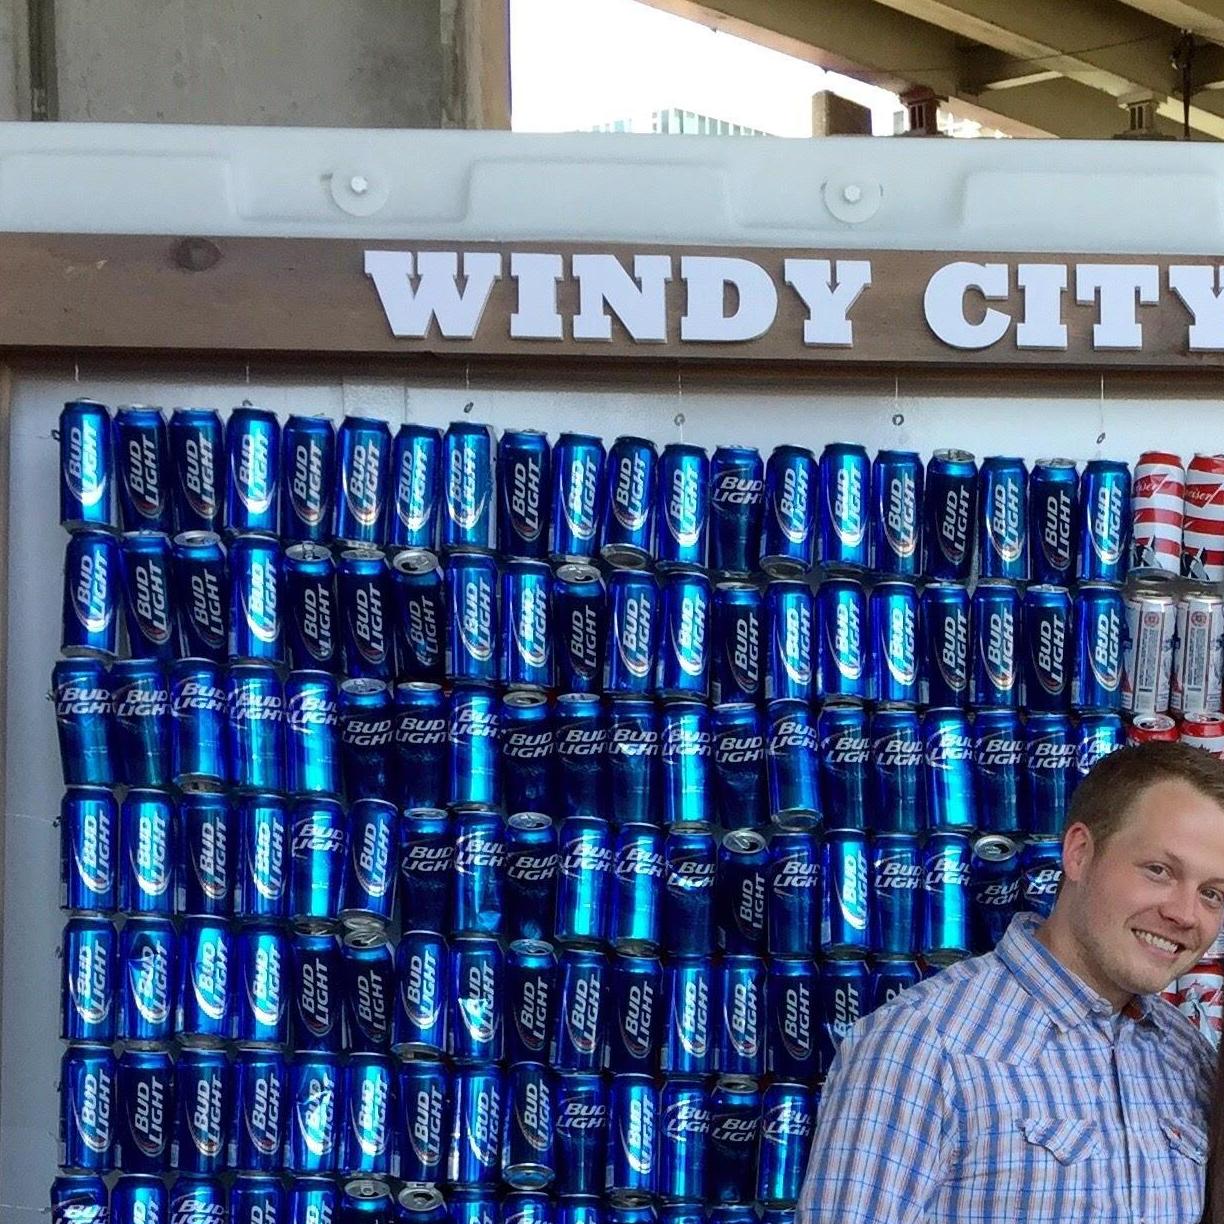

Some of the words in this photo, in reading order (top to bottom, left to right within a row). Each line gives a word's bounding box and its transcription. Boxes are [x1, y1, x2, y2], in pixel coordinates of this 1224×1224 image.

[363, 249, 872, 348] WINDY
[69, 426, 82, 478] BUD
[130, 440, 142, 495] BUD
[143, 434, 158, 508] LIGHT
[186, 440, 199, 494] BUD
[200, 436, 214, 513] LIGHT
[239, 435, 254, 481] BUD
[294, 445, 306, 498] BUD
[307, 440, 323, 513] LIGHT
[350, 445, 365, 496] BUD
[363, 439, 381, 518] LIGHT
[512, 463, 527, 516] BUD
[526, 458, 540, 532] LIGHT
[617, 458, 631, 506] BUD
[629, 452, 646, 519] LIGHT
[670, 468, 683, 519] BUD
[721, 477, 762, 491] BUD
[780, 468, 794, 517] BUD
[792, 464, 809, 531] LIGHT
[889, 478, 903, 529] BUD
[901, 473, 916, 547] LIGHT
[943, 490, 957, 540] BUD
[955, 485, 970, 552] LIGHT
[994, 484, 1006, 535] BUD
[1005, 479, 1019, 554] LIGHT
[1045, 496, 1058, 547] BUD
[1058, 490, 1072, 559] LIGHT
[1095, 484, 1109, 537] BUD
[1108, 479, 1122, 554] LIGHT
[78, 555, 92, 605] BUD
[91, 550, 108, 625] LIGHT
[136, 567, 149, 620] BUD
[149, 560, 166, 639] LIGHT
[192, 576, 206, 626] BUD
[205, 568, 223, 639] LIGHT
[304, 589, 318, 637] BUD
[317, 583, 331, 657] LIGHT
[357, 589, 370, 641] BUD
[369, 583, 384, 651] LIGHT
[463, 582, 478, 634] BUD
[477, 577, 492, 651] LIGHT
[571, 611, 583, 658] BUD
[624, 599, 638, 646] BUD
[637, 594, 652, 669] LIGHT
[678, 598, 694, 646] BUD
[691, 595, 706, 669] LIGHT
[583, 605, 598, 677] LIGHT
[735, 619, 748, 669] BUD
[748, 612, 759, 681] LIGHT
[943, 615, 958, 667] BUD
[956, 611, 967, 679] LIGHT
[988, 613, 1002, 660] BUD
[1001, 608, 1014, 677] LIGHT
[1038, 620, 1051, 670] BUD
[1051, 614, 1066, 684] LIGHT
[1095, 613, 1108, 665] BUD
[1108, 608, 1122, 679] LIGHT
[63, 688, 107, 702] BUD
[509, 733, 552, 748] BUD
[720, 737, 762, 749] BUD
[772, 734, 816, 748] LIGH
[778, 722, 816, 736] BUD
[81, 815, 97, 868] BUD
[96, 810, 110, 884] LIGHT
[200, 822, 214, 876] BUD
[212, 818, 227, 896] LIGHT
[360, 822, 377, 871] BUD
[372, 819, 390, 896] LIGHT
[876, 875, 916, 888] LIGH
[883, 862, 922, 875] BUD
[302, 963, 314, 1013] BUD
[314, 958, 328, 1027] LIGHT
[357, 975, 370, 1021] BUD
[370, 969, 385, 1031] LIGHT
[408, 956, 422, 1003] BUD
[421, 950, 437, 1023] LIGHT
[572, 978, 587, 1030] BUD
[521, 982, 535, 1032] BUD
[533, 977, 549, 1048] LIGHT
[584, 974, 600, 1049] LIGHT
[626, 985, 641, 1036] BUD
[639, 981, 654, 1056] LIGHT
[786, 989, 798, 1037] BUD
[798, 984, 811, 1048] LIGHT
[82, 1073, 97, 1126] BUD
[96, 1069, 112, 1148] LIGHT
[135, 1081, 150, 1133] BUD
[149, 1076, 164, 1146] LIGHT
[195, 1079, 210, 1131] BUD
[209, 1075, 222, 1150] LIGHT
[252, 1079, 267, 1131] BUD
[265, 1073, 280, 1150] LIGHT
[415, 1091, 429, 1142] BUD
[428, 1085, 443, 1162] LIGHT
[524, 1083, 538, 1127] BUD
[535, 1079, 549, 1146] LIGHT
[178, 1201, 223, 1214] BUD
